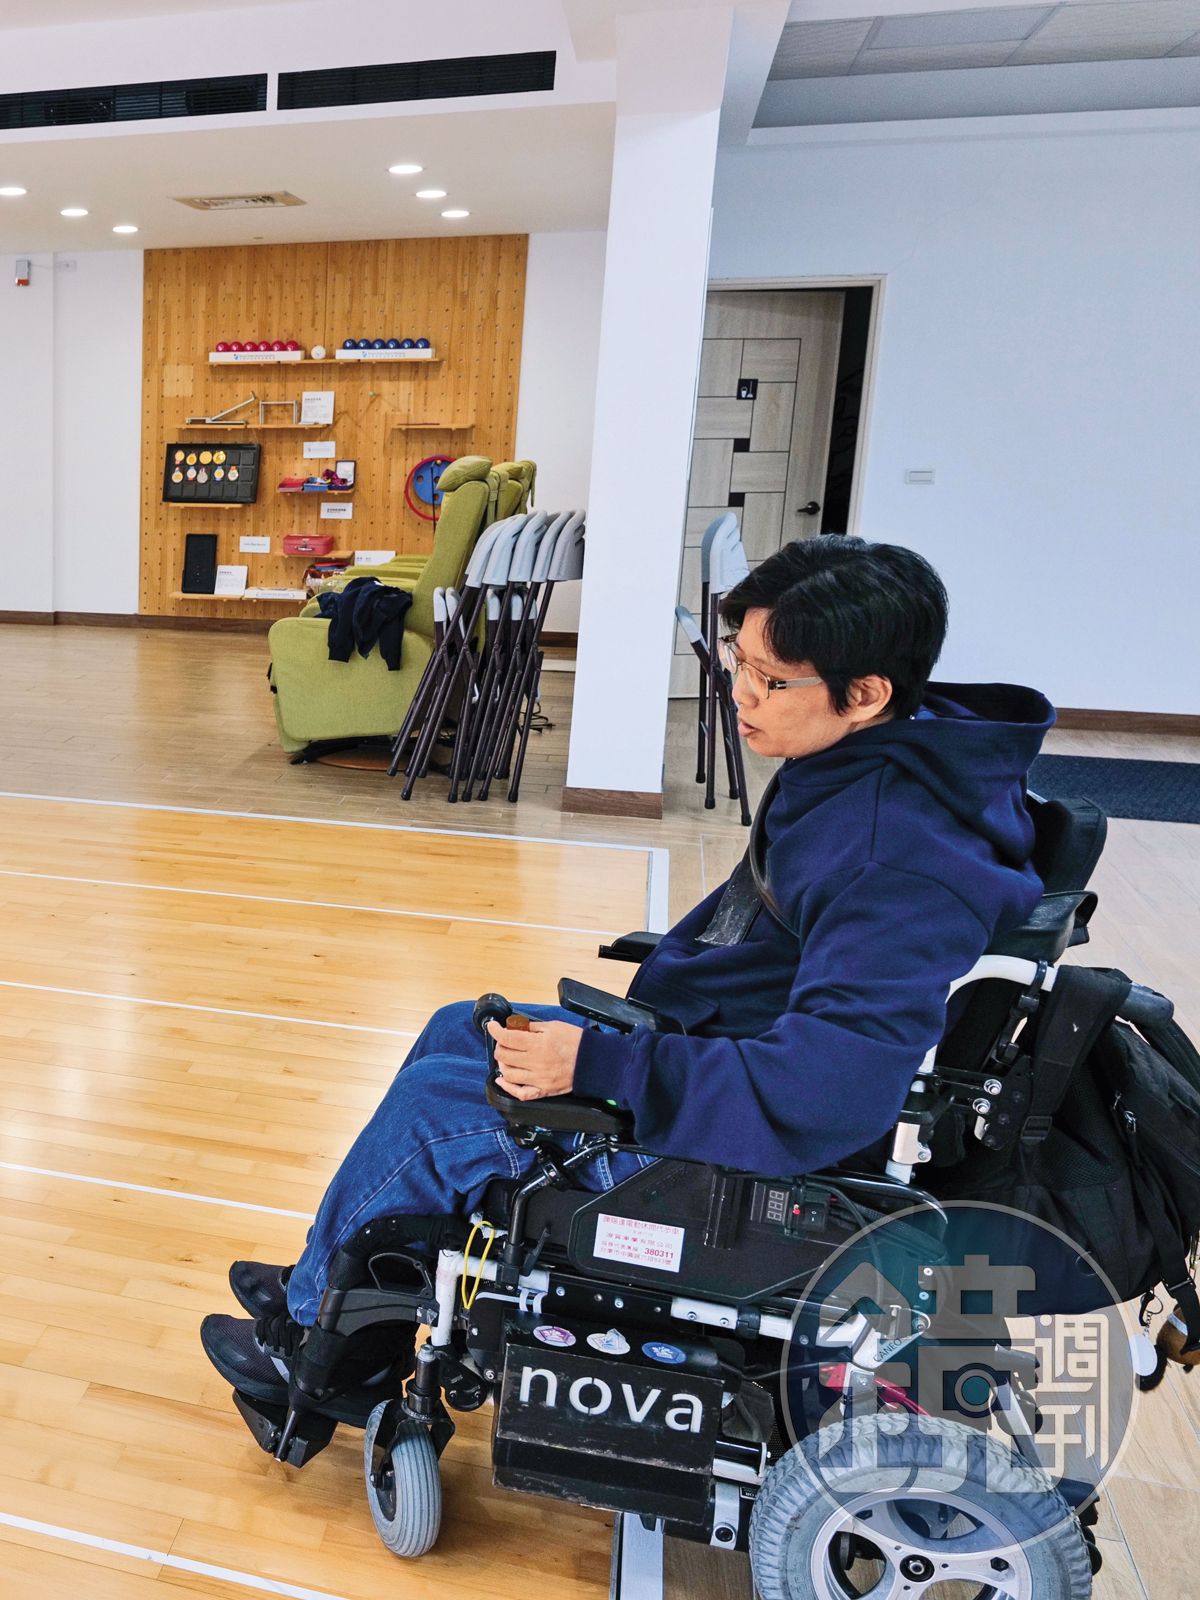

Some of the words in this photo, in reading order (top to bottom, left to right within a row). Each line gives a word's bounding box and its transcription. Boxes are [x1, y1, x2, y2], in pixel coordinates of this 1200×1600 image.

[645, 1247, 674, 1259] 380311
[873, 1337, 903, 1362] CANEO
[519, 1366, 703, 1433] nova
